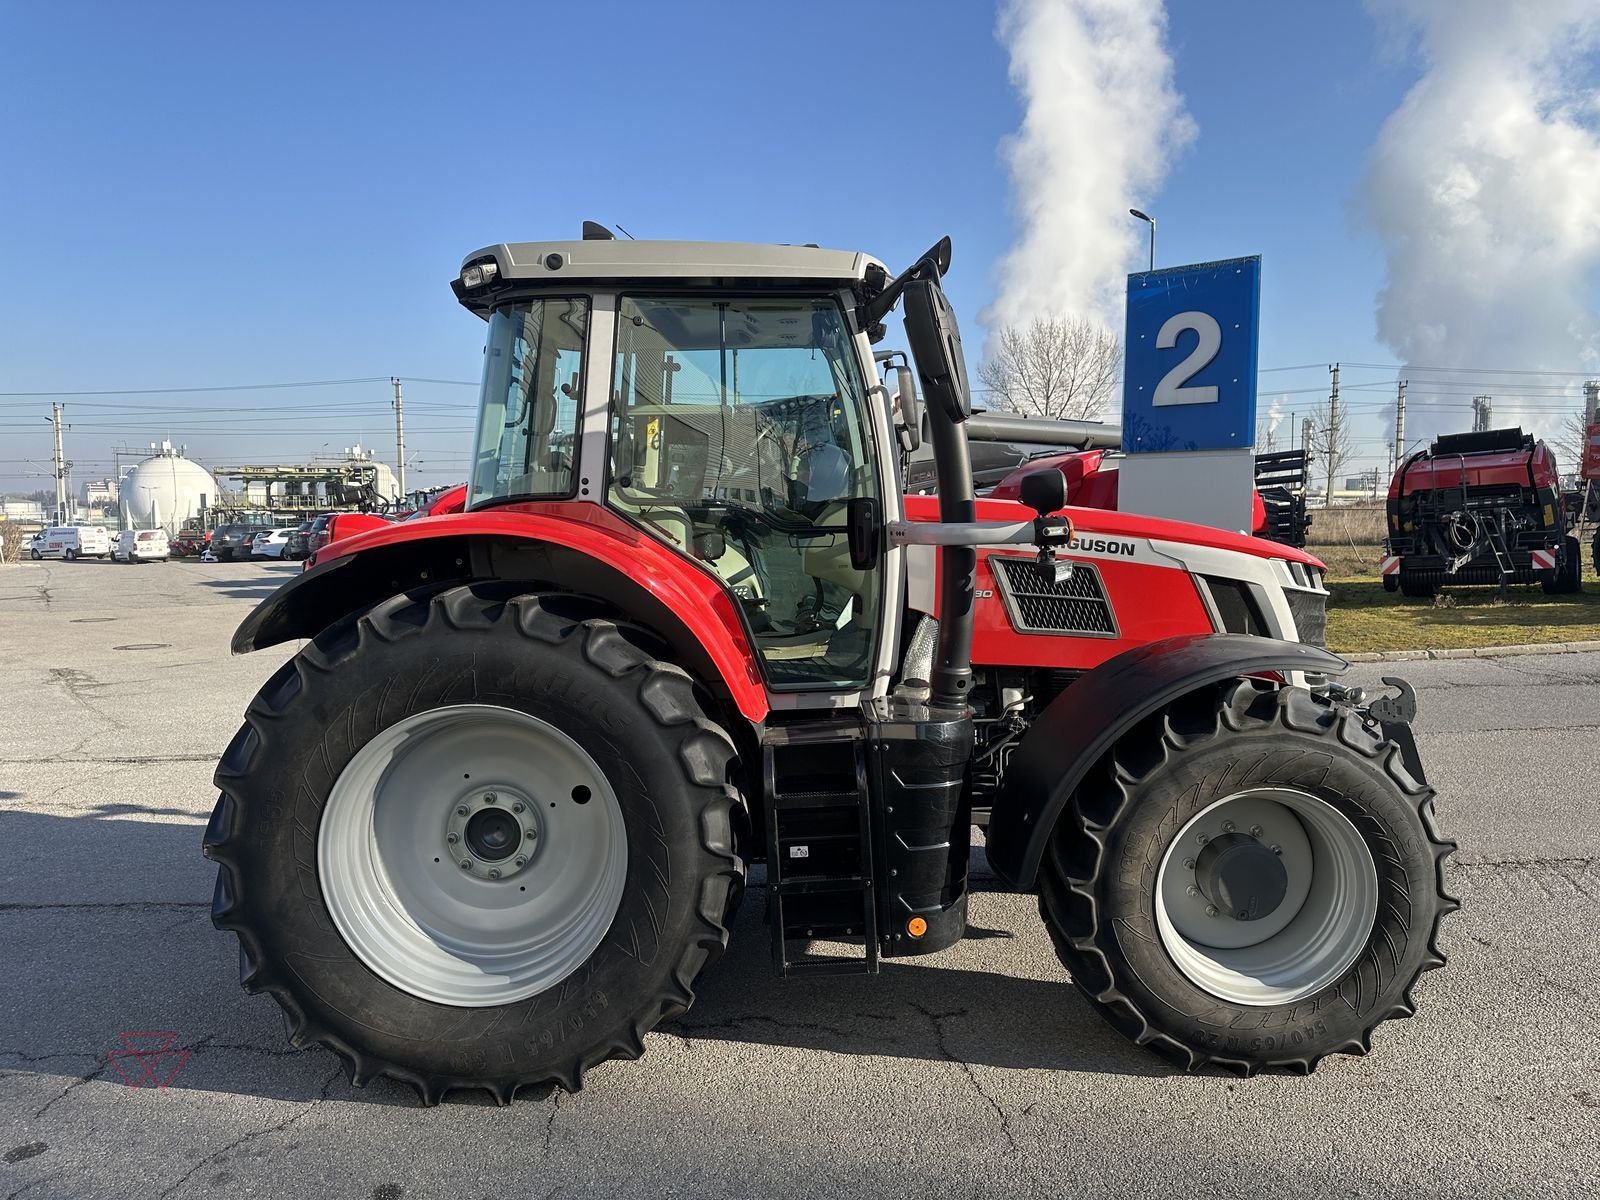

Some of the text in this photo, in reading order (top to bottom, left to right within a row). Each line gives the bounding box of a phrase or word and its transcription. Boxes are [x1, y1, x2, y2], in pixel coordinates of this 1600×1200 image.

[1152, 311, 1222, 407] 2
[1052, 536, 1136, 556] GUSON
[1250, 1019, 1329, 1050] 540/65
